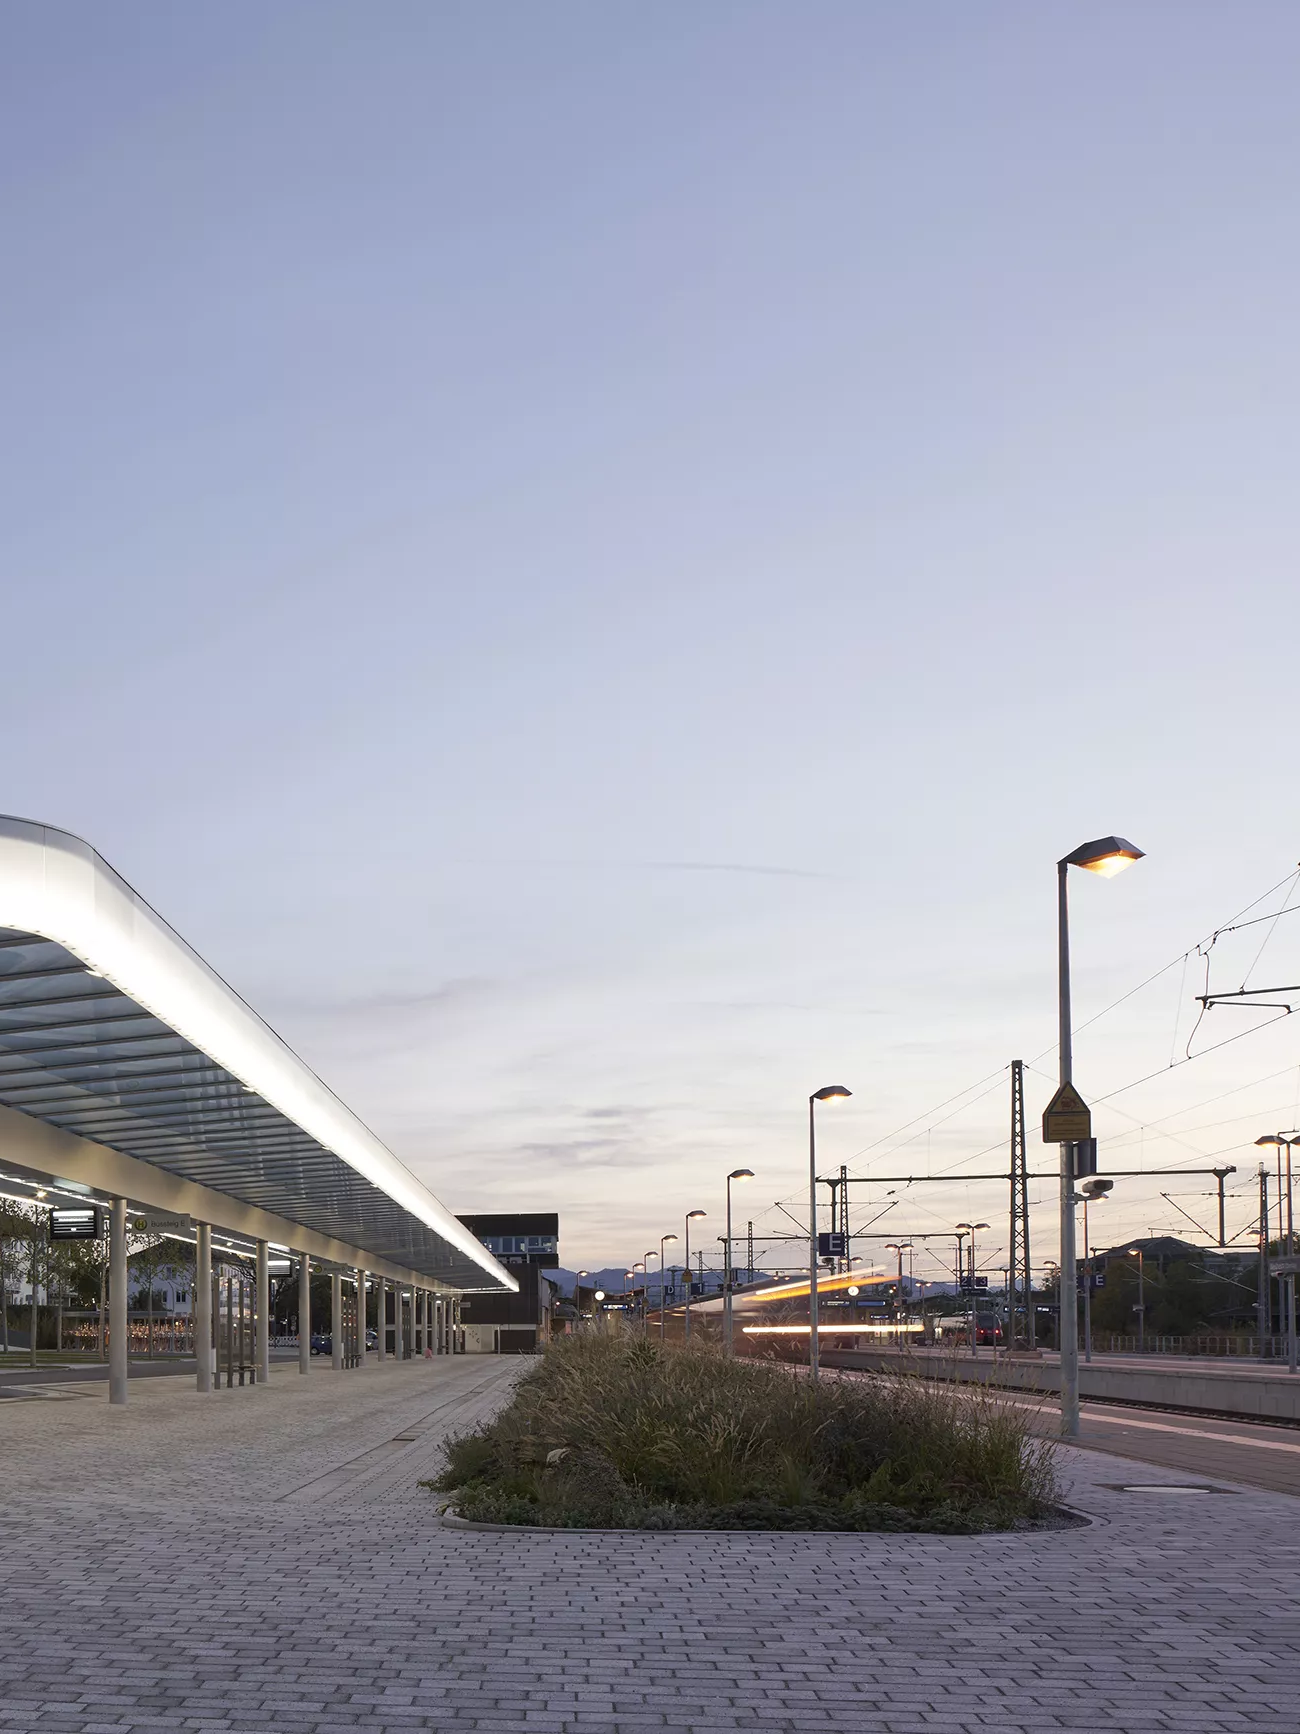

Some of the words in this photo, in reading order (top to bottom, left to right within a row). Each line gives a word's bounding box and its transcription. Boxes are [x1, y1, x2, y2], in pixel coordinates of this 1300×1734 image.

[150, 1220, 179, 1228] Bussteig
[829, 1233, 842, 1251] E
[961, 1277, 967, 1285] 2
[980, 1277, 986, 1285] 3
[1096, 1274, 1103, 1285] E
[667, 1285, 674, 1294] D
[697, 1283, 702, 1293] 1
